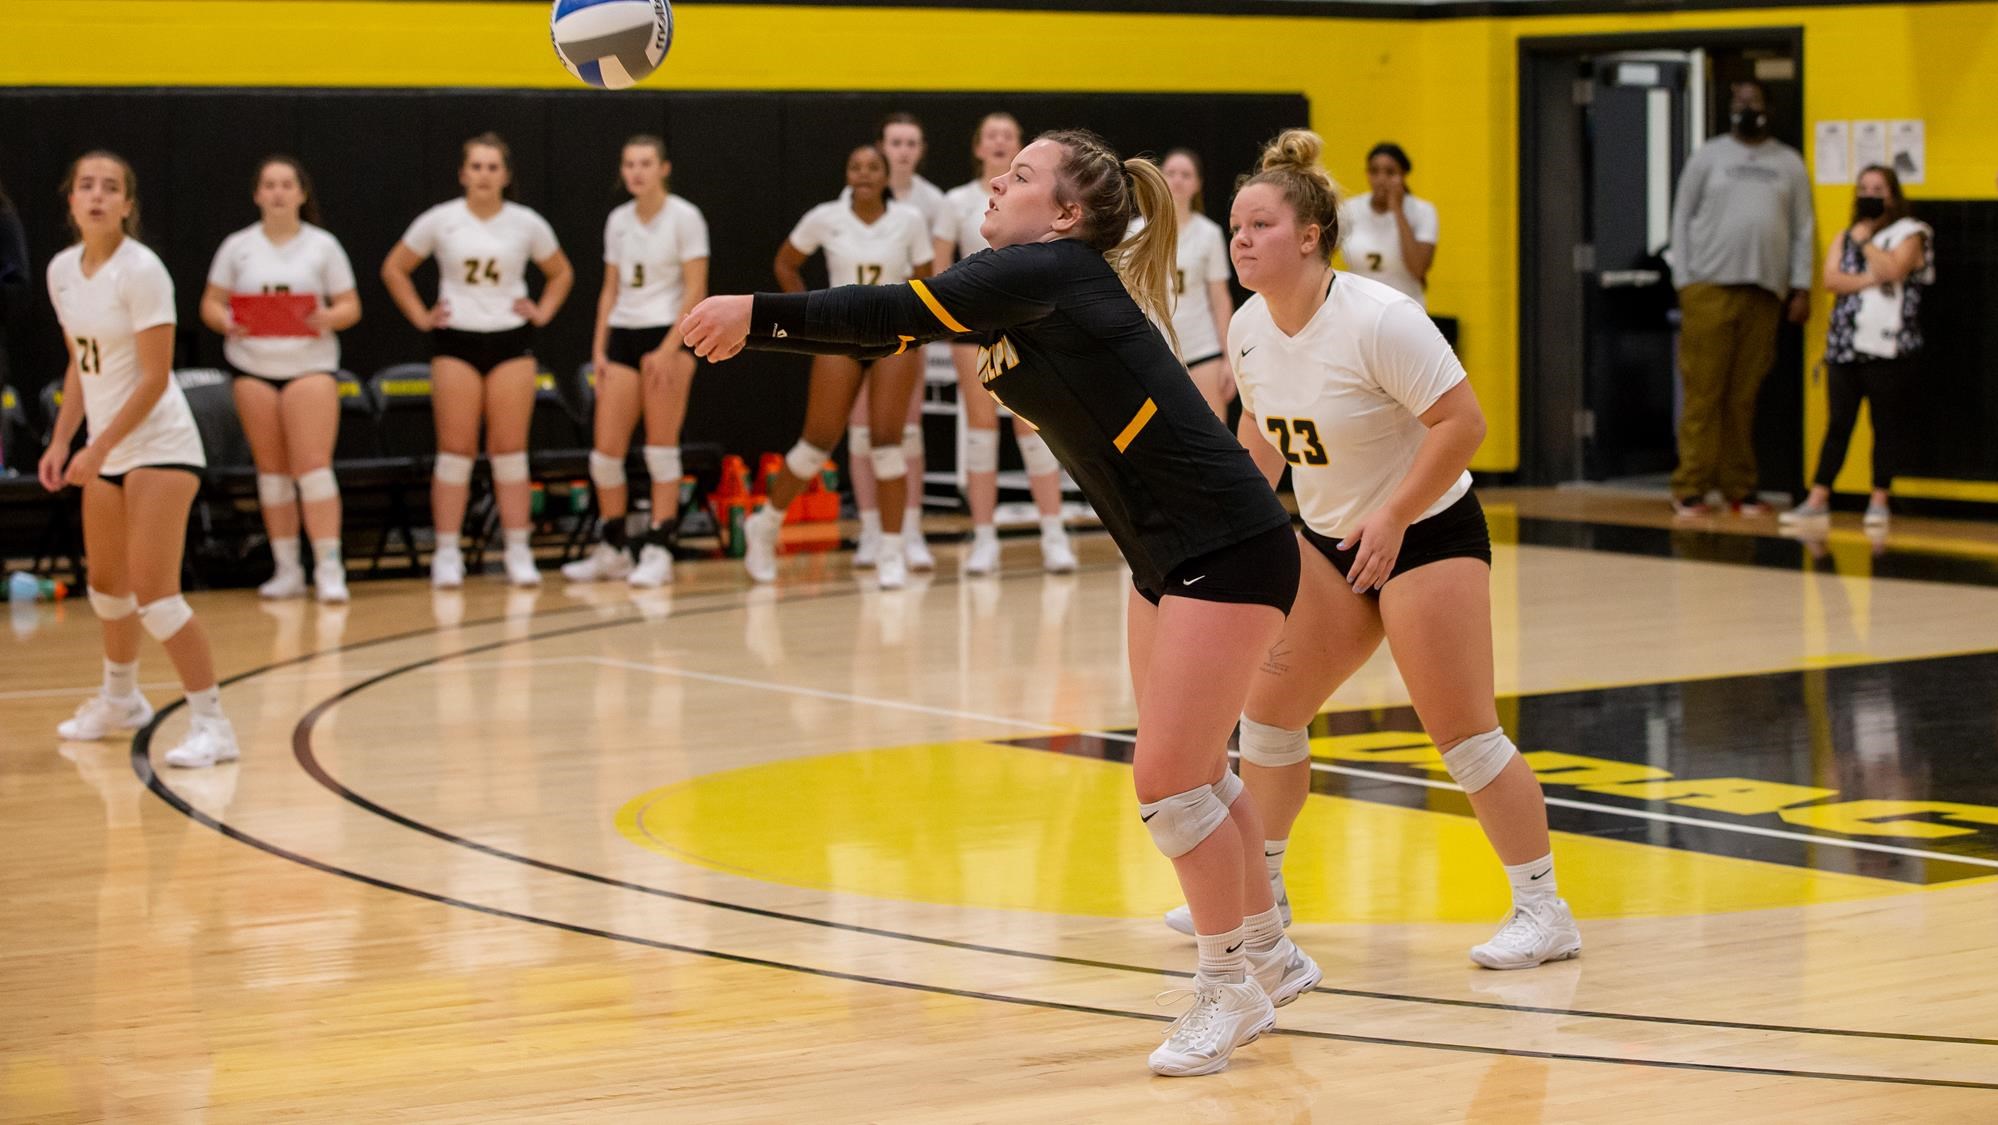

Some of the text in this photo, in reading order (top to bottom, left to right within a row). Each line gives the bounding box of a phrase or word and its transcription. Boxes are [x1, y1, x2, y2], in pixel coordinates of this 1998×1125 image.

[464, 258, 500, 286] 24
[75, 336, 101, 376] 21
[1266, 416, 1330, 467] 23
